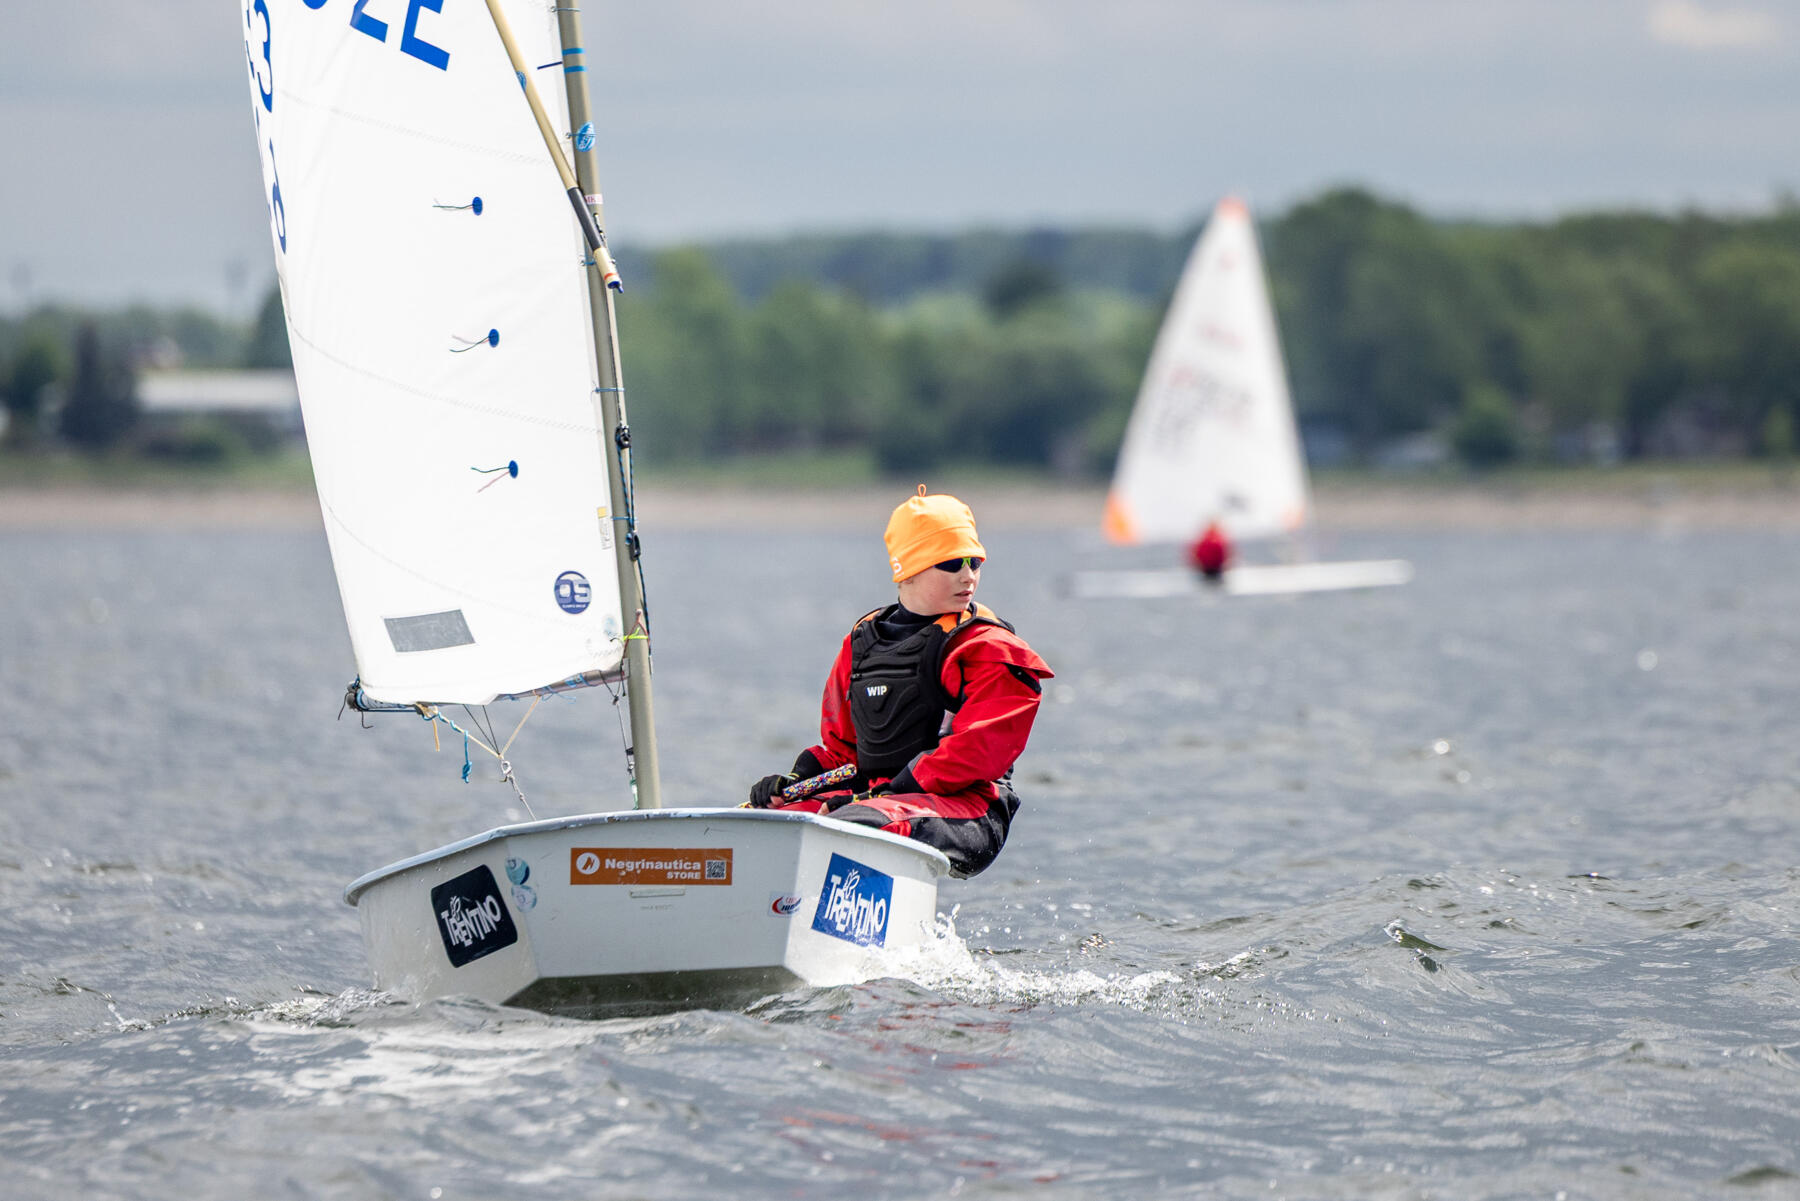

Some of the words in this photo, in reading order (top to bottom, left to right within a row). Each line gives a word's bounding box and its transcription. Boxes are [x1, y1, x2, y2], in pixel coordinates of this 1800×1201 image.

[866, 685, 888, 697] WIP
[605, 858, 701, 871] Negrinautica
[667, 871, 701, 880] STORE
[824, 873, 887, 940] TRENTINO
[441, 895, 501, 947] TRENTINO
